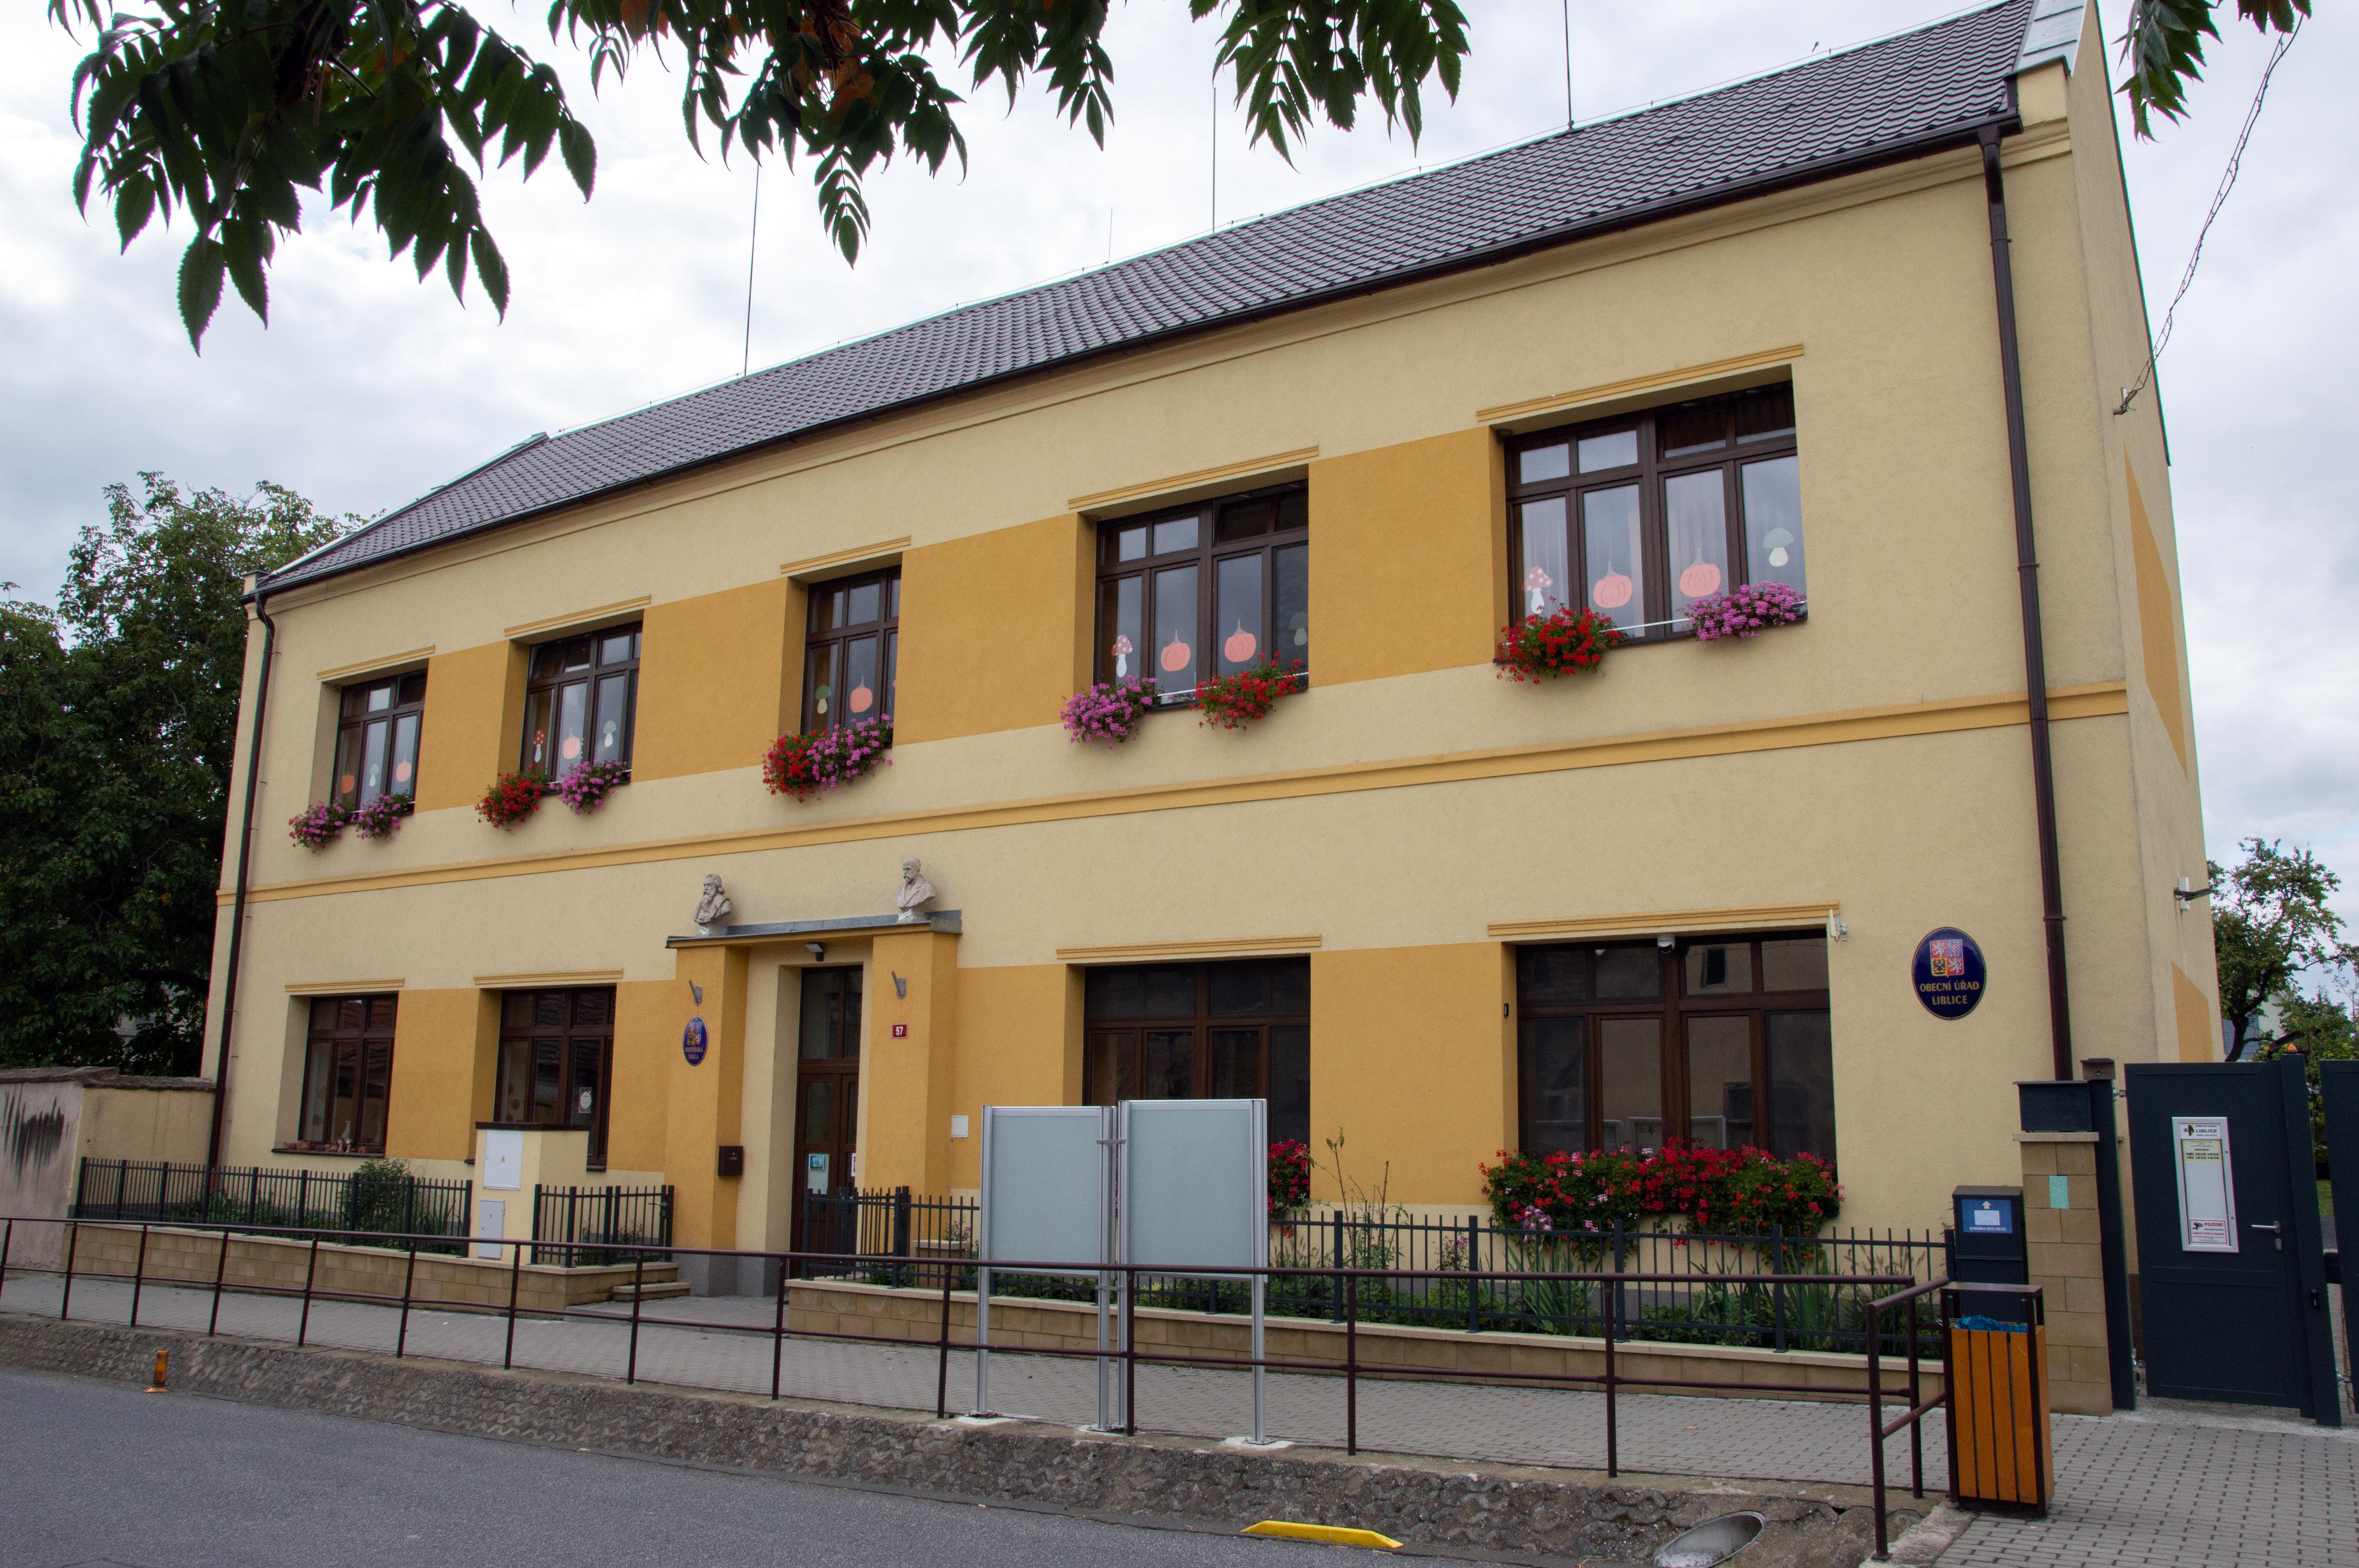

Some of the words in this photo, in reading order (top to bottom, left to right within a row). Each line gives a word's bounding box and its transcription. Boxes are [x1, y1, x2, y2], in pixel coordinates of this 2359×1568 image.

[1920, 980, 1951, 992] OBECNÍ
[1954, 979, 1980, 991] ÚŘAD
[1932, 995, 1968, 1005] LIBLICE
[896, 1026, 903, 1036] 57
